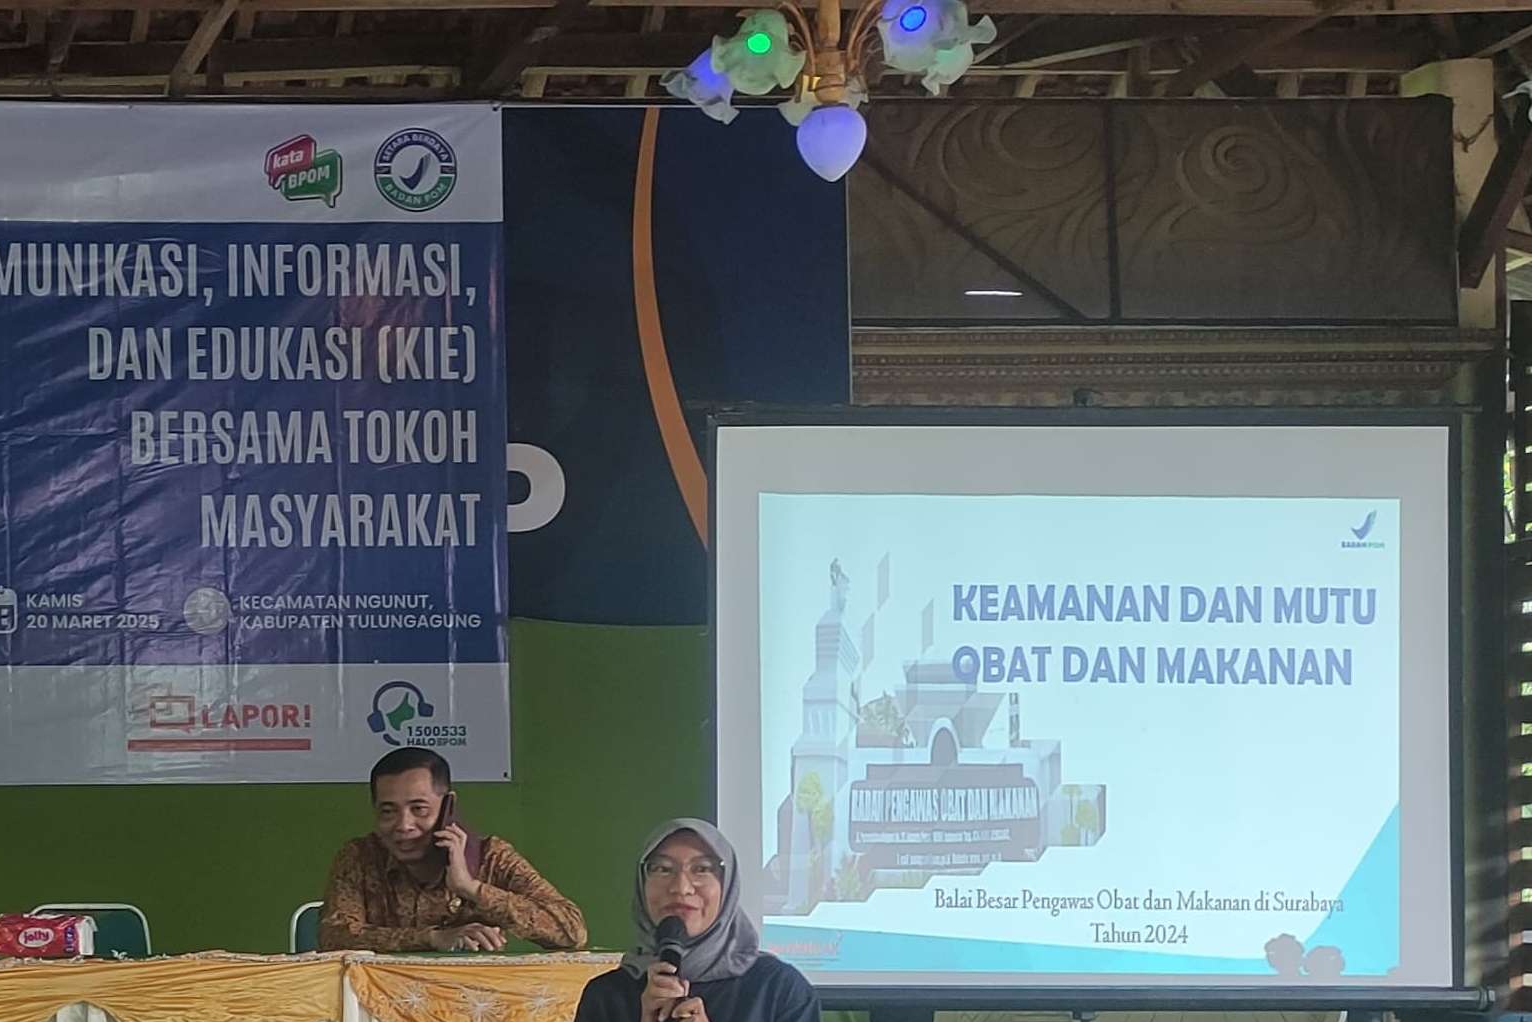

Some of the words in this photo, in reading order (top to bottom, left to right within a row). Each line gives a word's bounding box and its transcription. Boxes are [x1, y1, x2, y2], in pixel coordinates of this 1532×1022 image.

[273, 150, 304, 169] kata
[288, 165, 330, 189] BPOM
[227, 243, 477, 307] INFORMASI,
[87, 327, 173, 381] DAN
[187, 326, 362, 381] EDUKASI
[377, 325, 477, 384] (KIE)
[131, 410, 333, 465] BERSAMA
[343, 409, 478, 464] TOKOH
[200, 493, 481, 548] MASYARAKAT
[26, 594, 84, 609] KAMIS
[239, 595, 351, 610] KECAMATAN
[355, 594, 435, 611] NGUNUT,
[952, 584, 1171, 623] KEAMANAN
[1179, 586, 1263, 624] DAN
[1273, 587, 1377, 625] MUTU
[26, 615, 48, 629] 20
[52, 615, 113, 630] MARET
[116, 614, 161, 630] 2025
[239, 614, 344, 630] KABUPATEN
[347, 613, 482, 629] TULUNGAGUNG
[952, 645, 1053, 684] OBAT
[1062, 645, 1147, 684] DAN
[1156, 647, 1353, 686] MAKANAN
[202, 703, 312, 729] LAPOR!
[407, 726, 467, 737] 1500533
[934, 888, 973, 909] Balai
[976, 888, 1018, 910] Besar
[1022, 889, 1094, 917] Pengawas
[1097, 889, 1139, 910] Obat
[1142, 889, 1172, 911] dan
[1176, 890, 1251, 911] Makanan
[1254, 891, 1270, 912] di
[1273, 891, 1344, 919] Surabaya
[1089, 922, 1142, 944] Tahun
[1144, 924, 1189, 944] 2024
